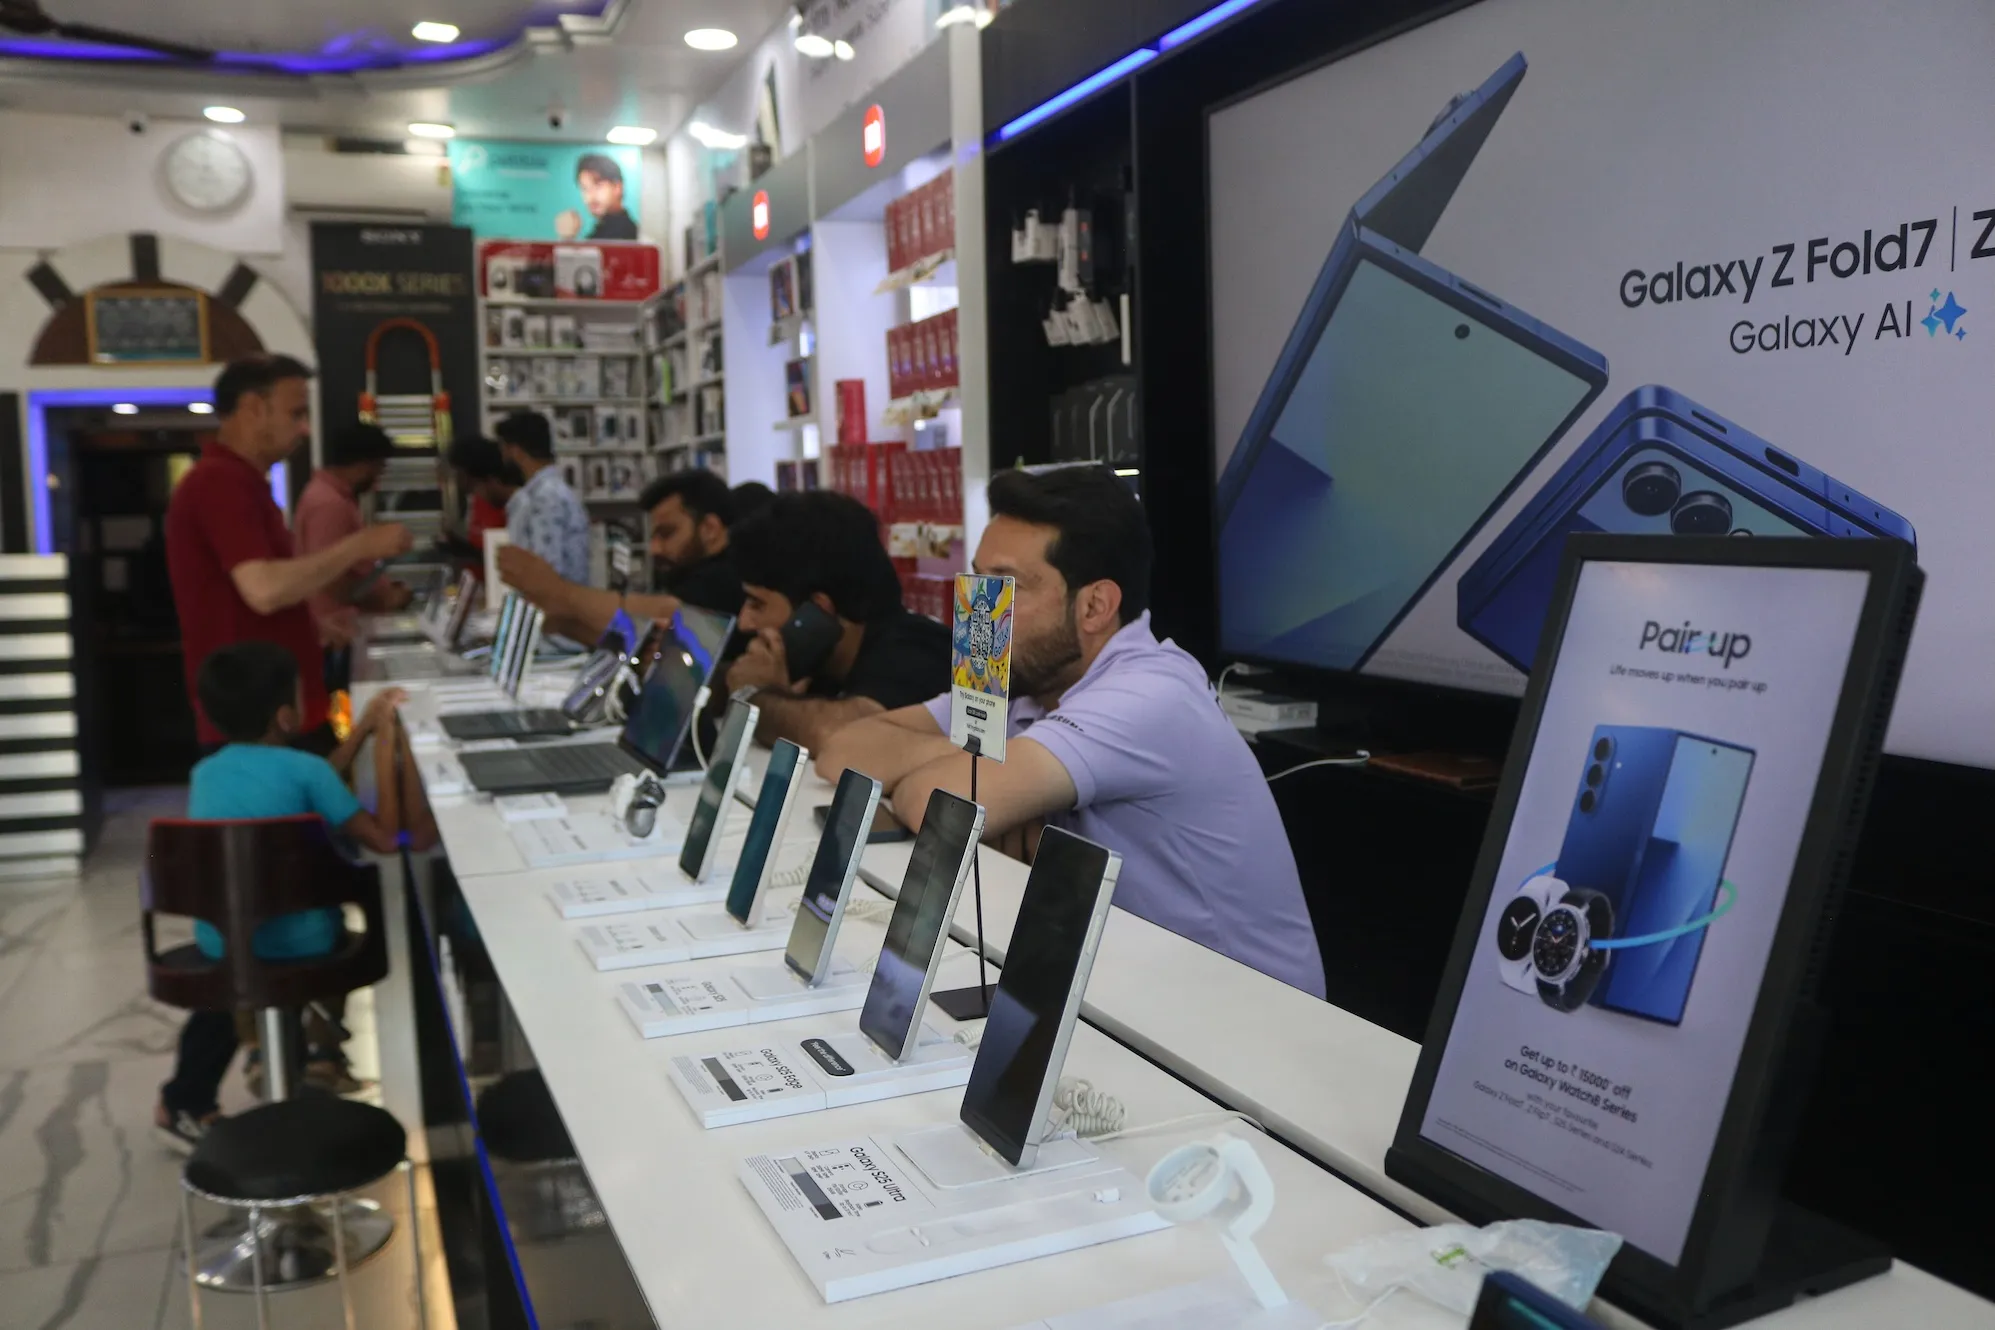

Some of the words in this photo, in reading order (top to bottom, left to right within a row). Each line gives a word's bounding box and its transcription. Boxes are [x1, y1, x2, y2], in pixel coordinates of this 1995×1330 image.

[1619, 256, 1764, 308] Galaxy
[1771, 243, 1795, 288] Z
[1806, 218, 1938, 283] Fold7
[1729, 313, 1865, 356] Galaxy
[1875, 301, 1912, 340] AI
[1639, 620, 1702, 654] Pair
[1708, 631, 1752, 669] up
[1610, 664, 1627, 676] Life
[1628, 668, 1660, 680] moves
[1661, 672, 1675, 684] up
[1676, 672, 1706, 686] when
[1706, 676, 1726, 690] you
[1752, 681, 1768, 696] up
[760, 1048, 783, 1067] Galaxy
[775, 1065, 793, 1076] S25
[783, 1074, 803, 1089] Edge
[1520, 1045, 1540, 1062] Get
[1541, 1055, 1556, 1070] up
[1557, 1060, 1569, 1074] to
[1612, 1084, 1632, 1100] off
[1504, 1059, 1519, 1072] on
[1520, 1063, 1557, 1090] Galaxy
[1558, 1080, 1601, 1107] Watch8
[1601, 1098, 1638, 1124] Series
[850, 1147, 879, 1171] Galaxy
[871, 1171, 892, 1184] S25
[883, 1183, 906, 1202] Ultra
